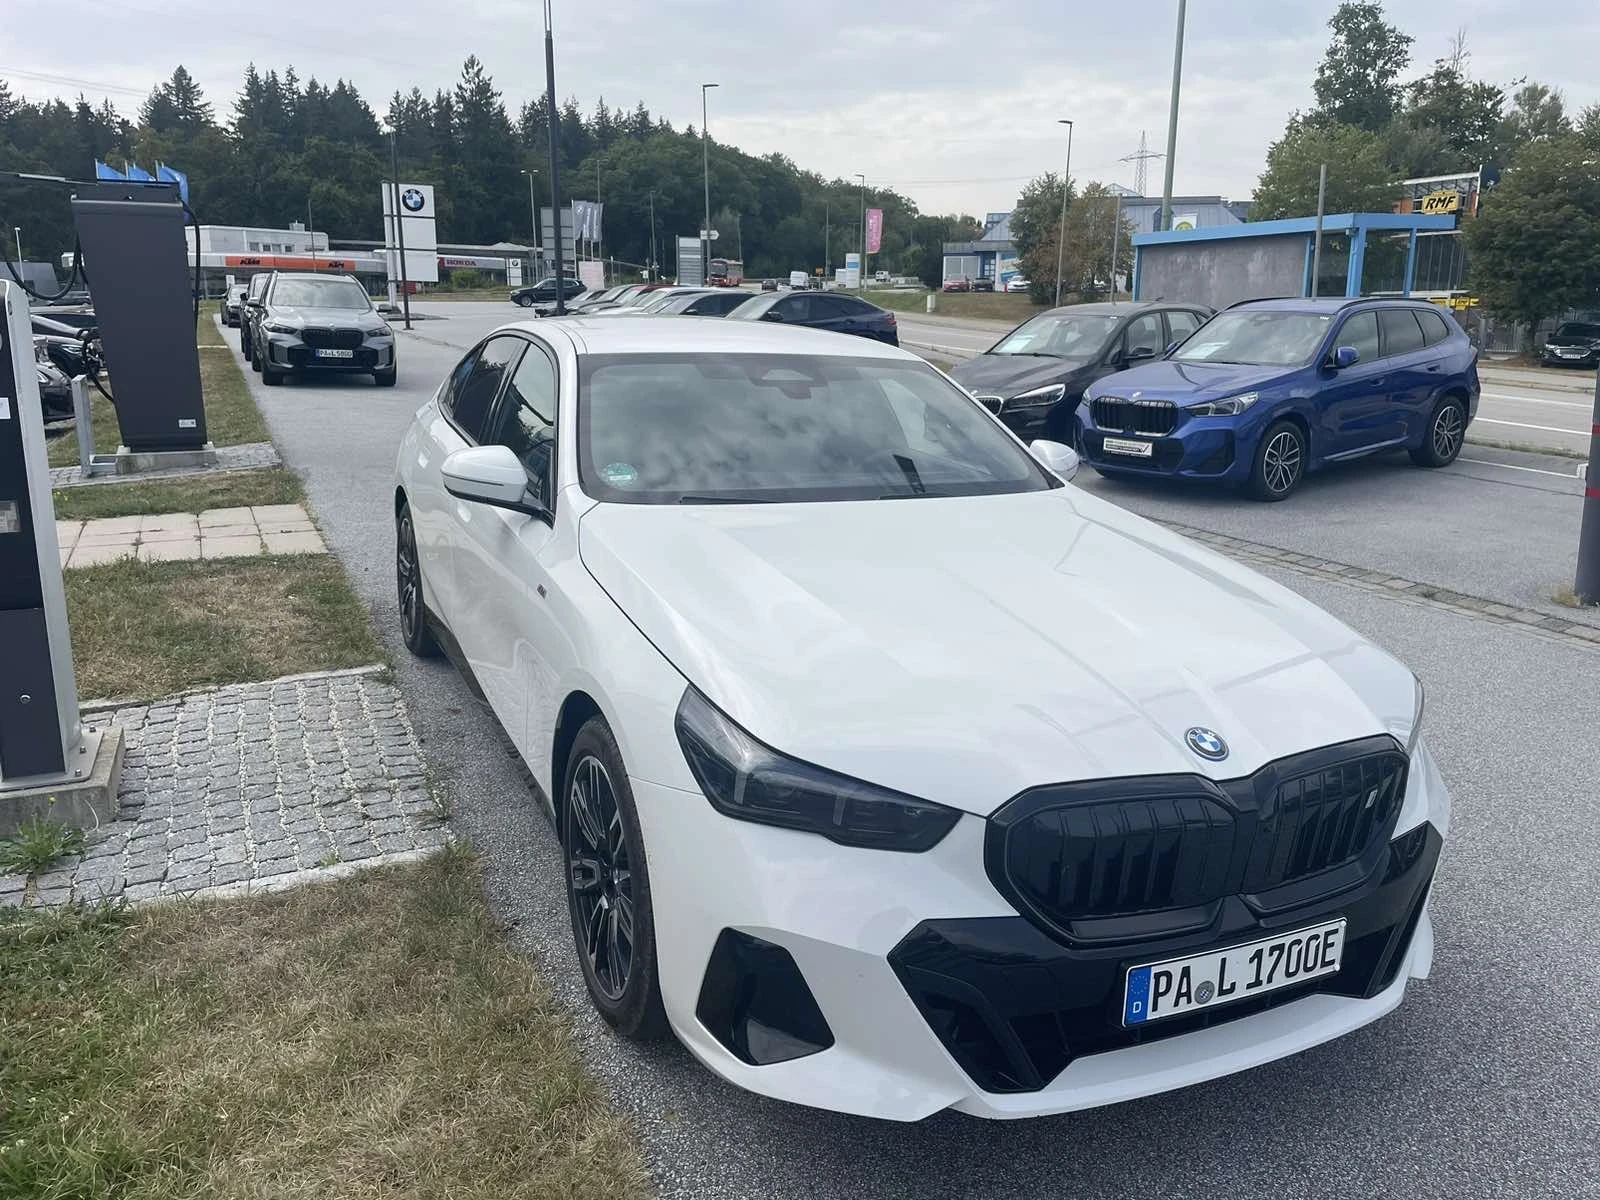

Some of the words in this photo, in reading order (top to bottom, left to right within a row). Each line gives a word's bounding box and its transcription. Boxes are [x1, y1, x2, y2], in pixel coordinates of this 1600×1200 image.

[1425, 196, 1456, 210] RMF
[446, 259, 476, 267] HONDA
[1152, 965, 1192, 1013] PA
[1217, 957, 1236, 997] L
[1246, 928, 1339, 990] 1700E
[1133, 1002, 1142, 1014] D
